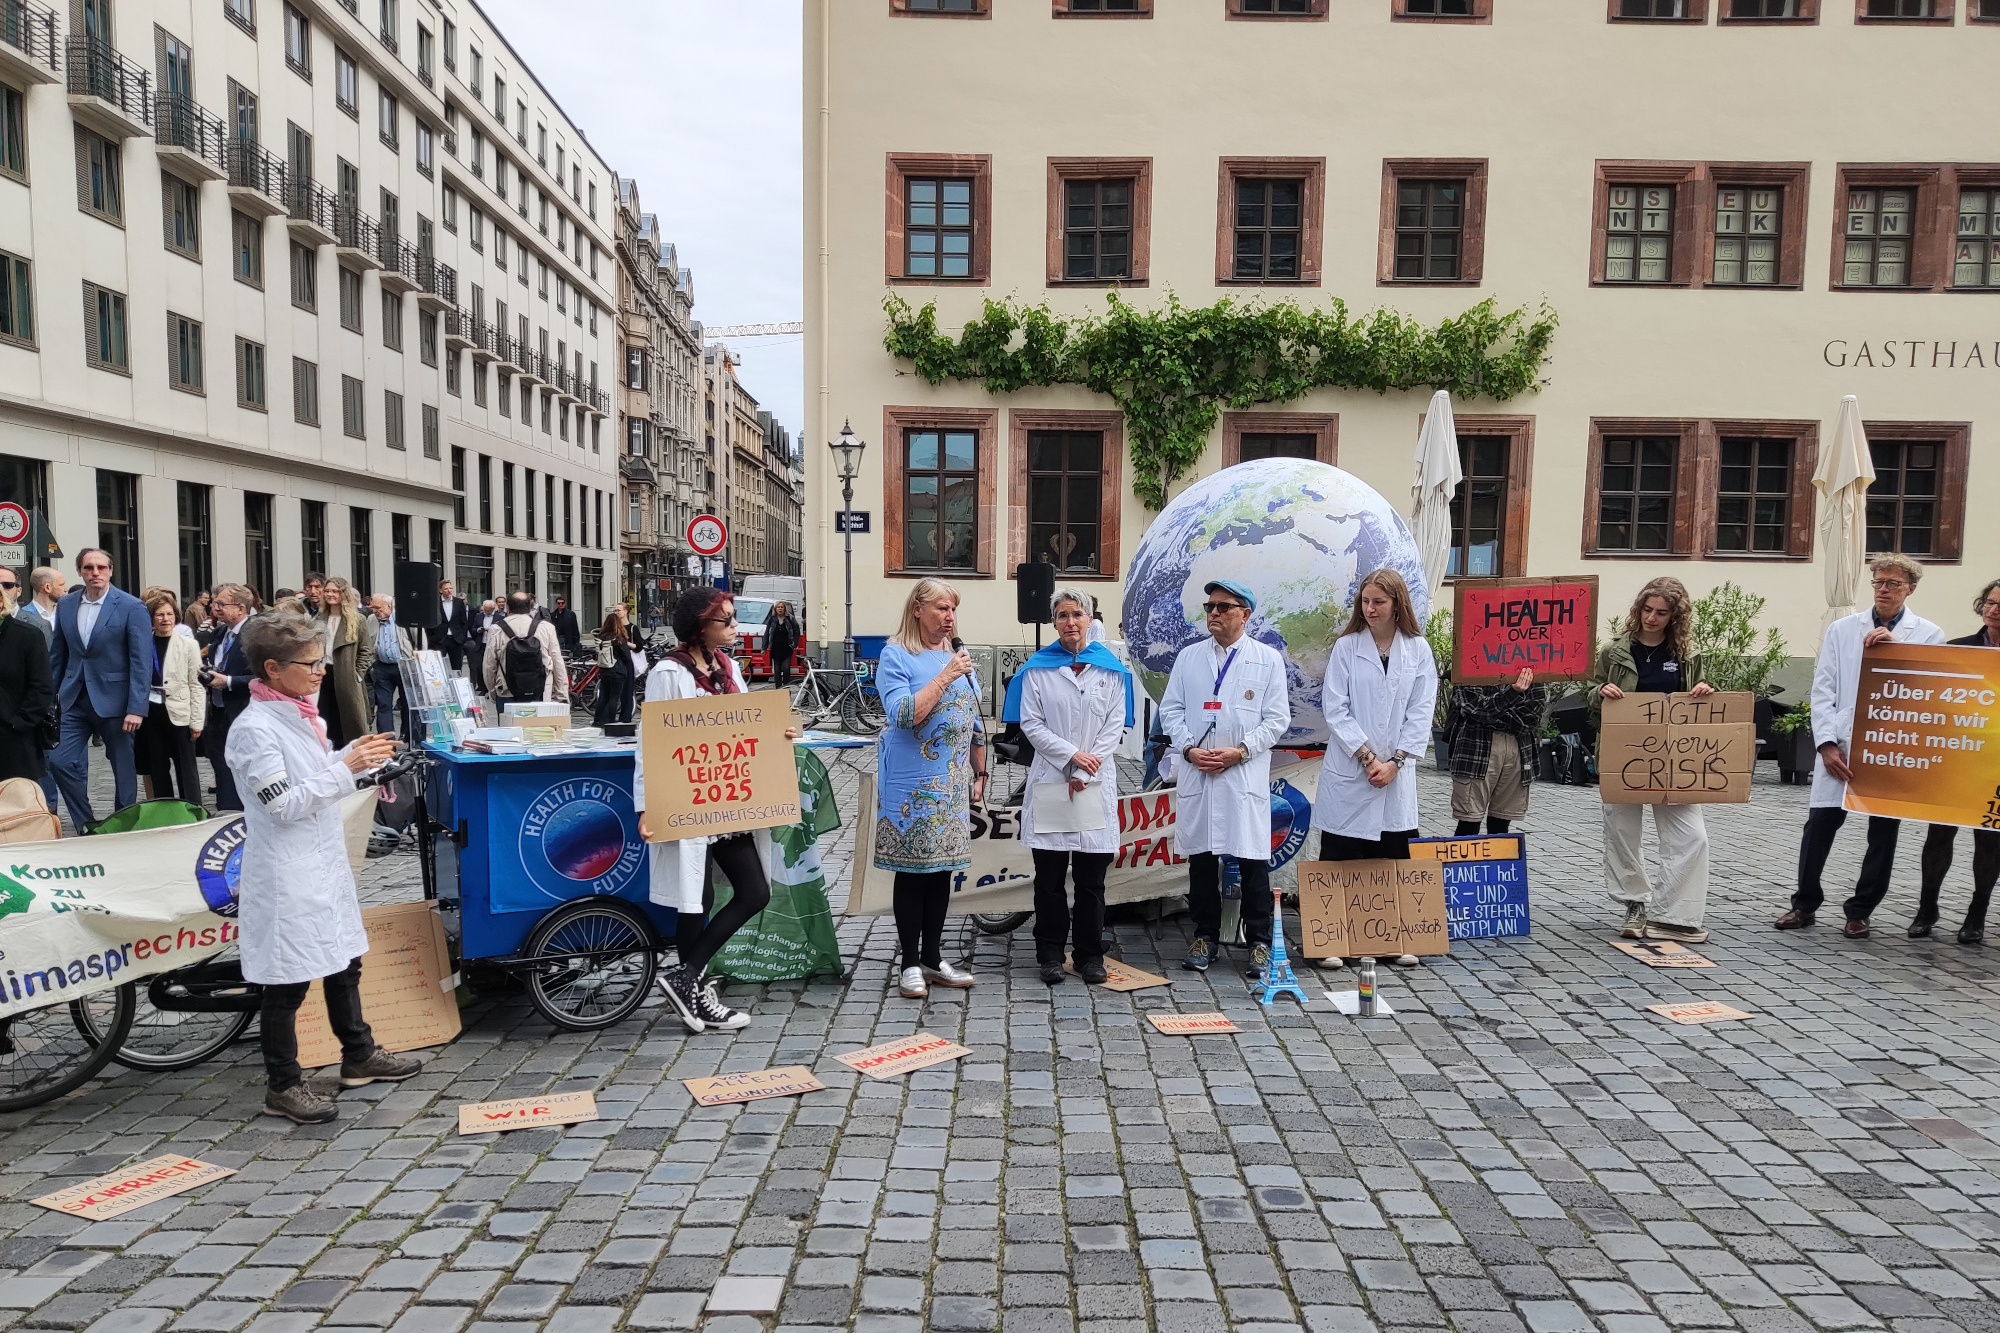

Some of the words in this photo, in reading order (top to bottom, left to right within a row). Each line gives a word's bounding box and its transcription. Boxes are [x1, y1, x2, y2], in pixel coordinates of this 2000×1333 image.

[1823, 340, 2000, 368] GASTHA
[1484, 598, 1574, 629] HEALTH
[1508, 626, 1550, 642] OVER
[1482, 642, 1564, 665] WEALTH
[662, 708, 763, 728] KLIMASCHUTZ
[1635, 700, 1727, 725] FIGTH
[1867, 705, 1946, 725] können
[1953, 713, 1989, 728] wir
[716, 733, 759, 762] DÄT
[1624, 736, 1734, 758] every
[1864, 728, 1919, 746] nicht
[1925, 735, 1985, 752] mehr
[1621, 757, 1729, 791] CRISIS
[692, 779, 753, 805] 2025
[525, 783, 576, 837] HEALTH
[581, 782, 615, 803] FOR
[667, 803, 797, 828] GESUNDHEITSSCHUTZ
[1436, 842, 1492, 859] HEUTE
[10, 863, 105, 880] Komm
[592, 841, 641, 895] FUTURE
[1443, 865, 1491, 884] PLANET
[1497, 863, 1519, 882] hat
[1349, 894, 1396, 913] AUCH
[1475, 904, 1526, 919] STEHEN
[767, 933, 803, 950] change
[766, 962, 788, 973] else
[851, 1039, 953, 1070] DEMOKRATIE
[701, 1080, 818, 1102] GESUNDHEIT
[707, 1073, 792, 1090] ALLEM
[483, 1107, 551, 1120] WIR
[62, 1159, 202, 1212] SICHERHEIT
